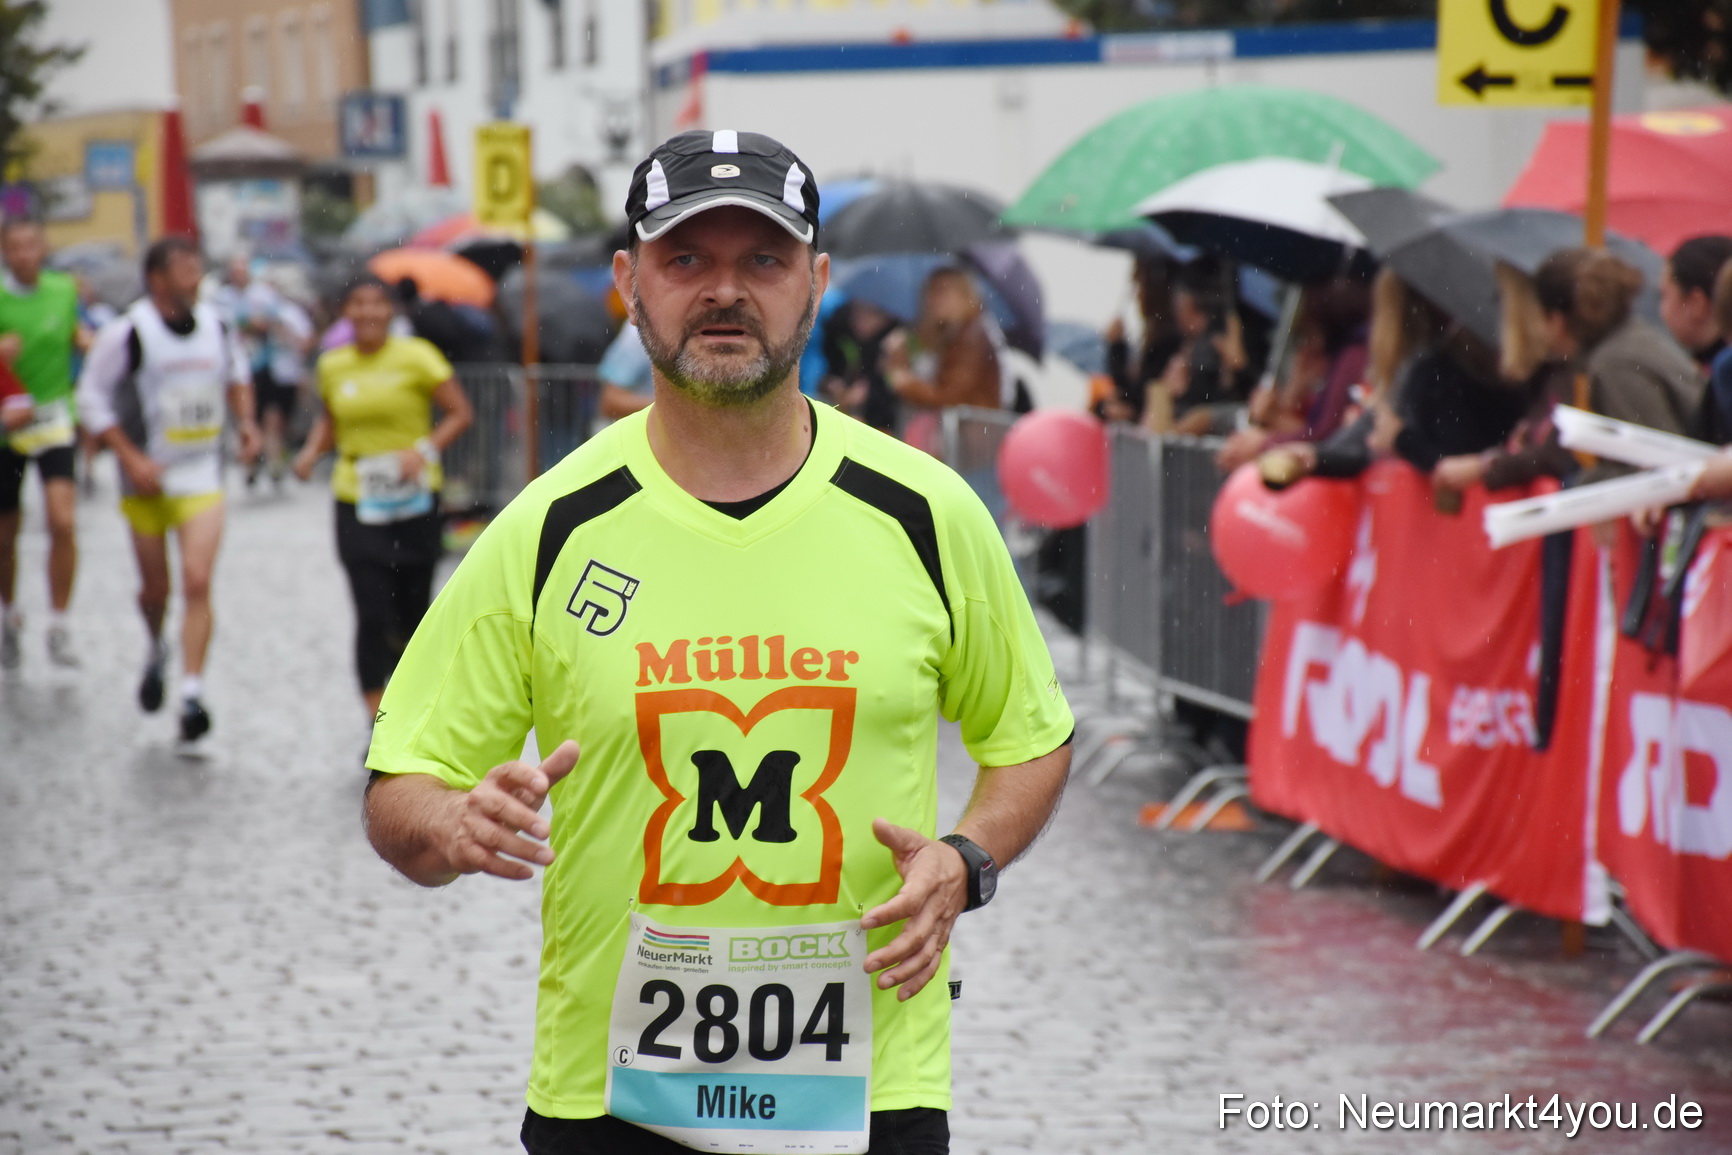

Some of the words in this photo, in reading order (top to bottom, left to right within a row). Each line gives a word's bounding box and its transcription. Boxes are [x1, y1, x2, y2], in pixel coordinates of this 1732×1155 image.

[635, 635, 860, 687] Müller
[688, 750, 801, 843] M
[637, 944, 713, 966] NeuerMarkt
[729, 931, 850, 962] BOCK
[728, 964, 765, 973] inspired
[768, 963, 778, 972] by
[782, 961, 808, 971] smart
[811, 960, 851, 971] concepts
[637, 979, 850, 1064] 2804
[697, 1085, 776, 1120] Mike
